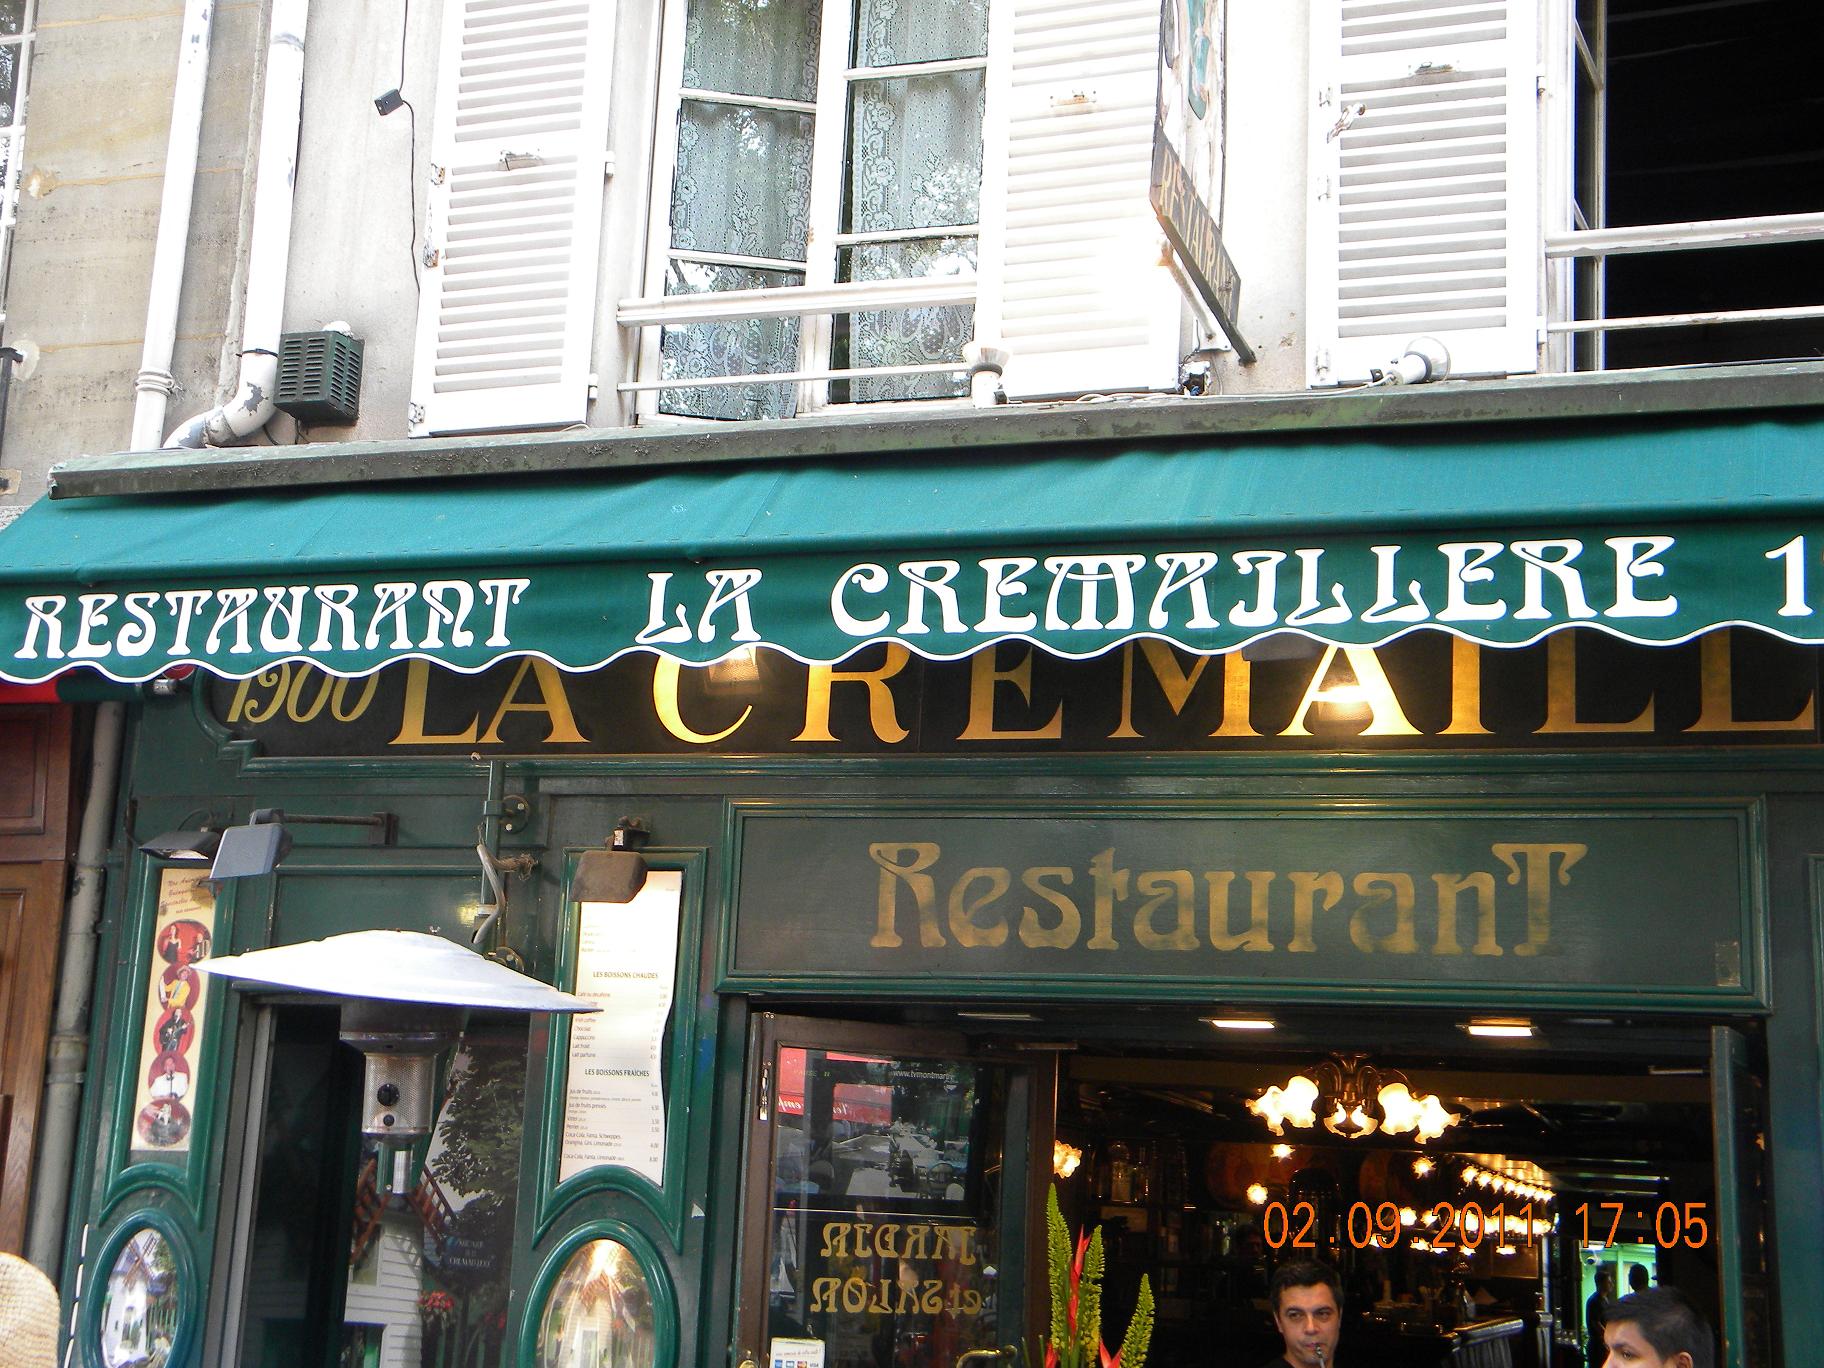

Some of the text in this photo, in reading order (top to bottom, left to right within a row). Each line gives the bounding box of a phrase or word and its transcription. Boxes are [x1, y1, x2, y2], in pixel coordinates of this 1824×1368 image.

[14, 578, 531, 661] RESTAURANT
[634, 568, 764, 649] LA
[1766, 535, 1812, 617] 1
[226, 657, 380, 724] 1900
[388, 652, 590, 746] LA
[585, 1068, 595, 1076] LES
[596, 1068, 623, 1077] BOISSONS
